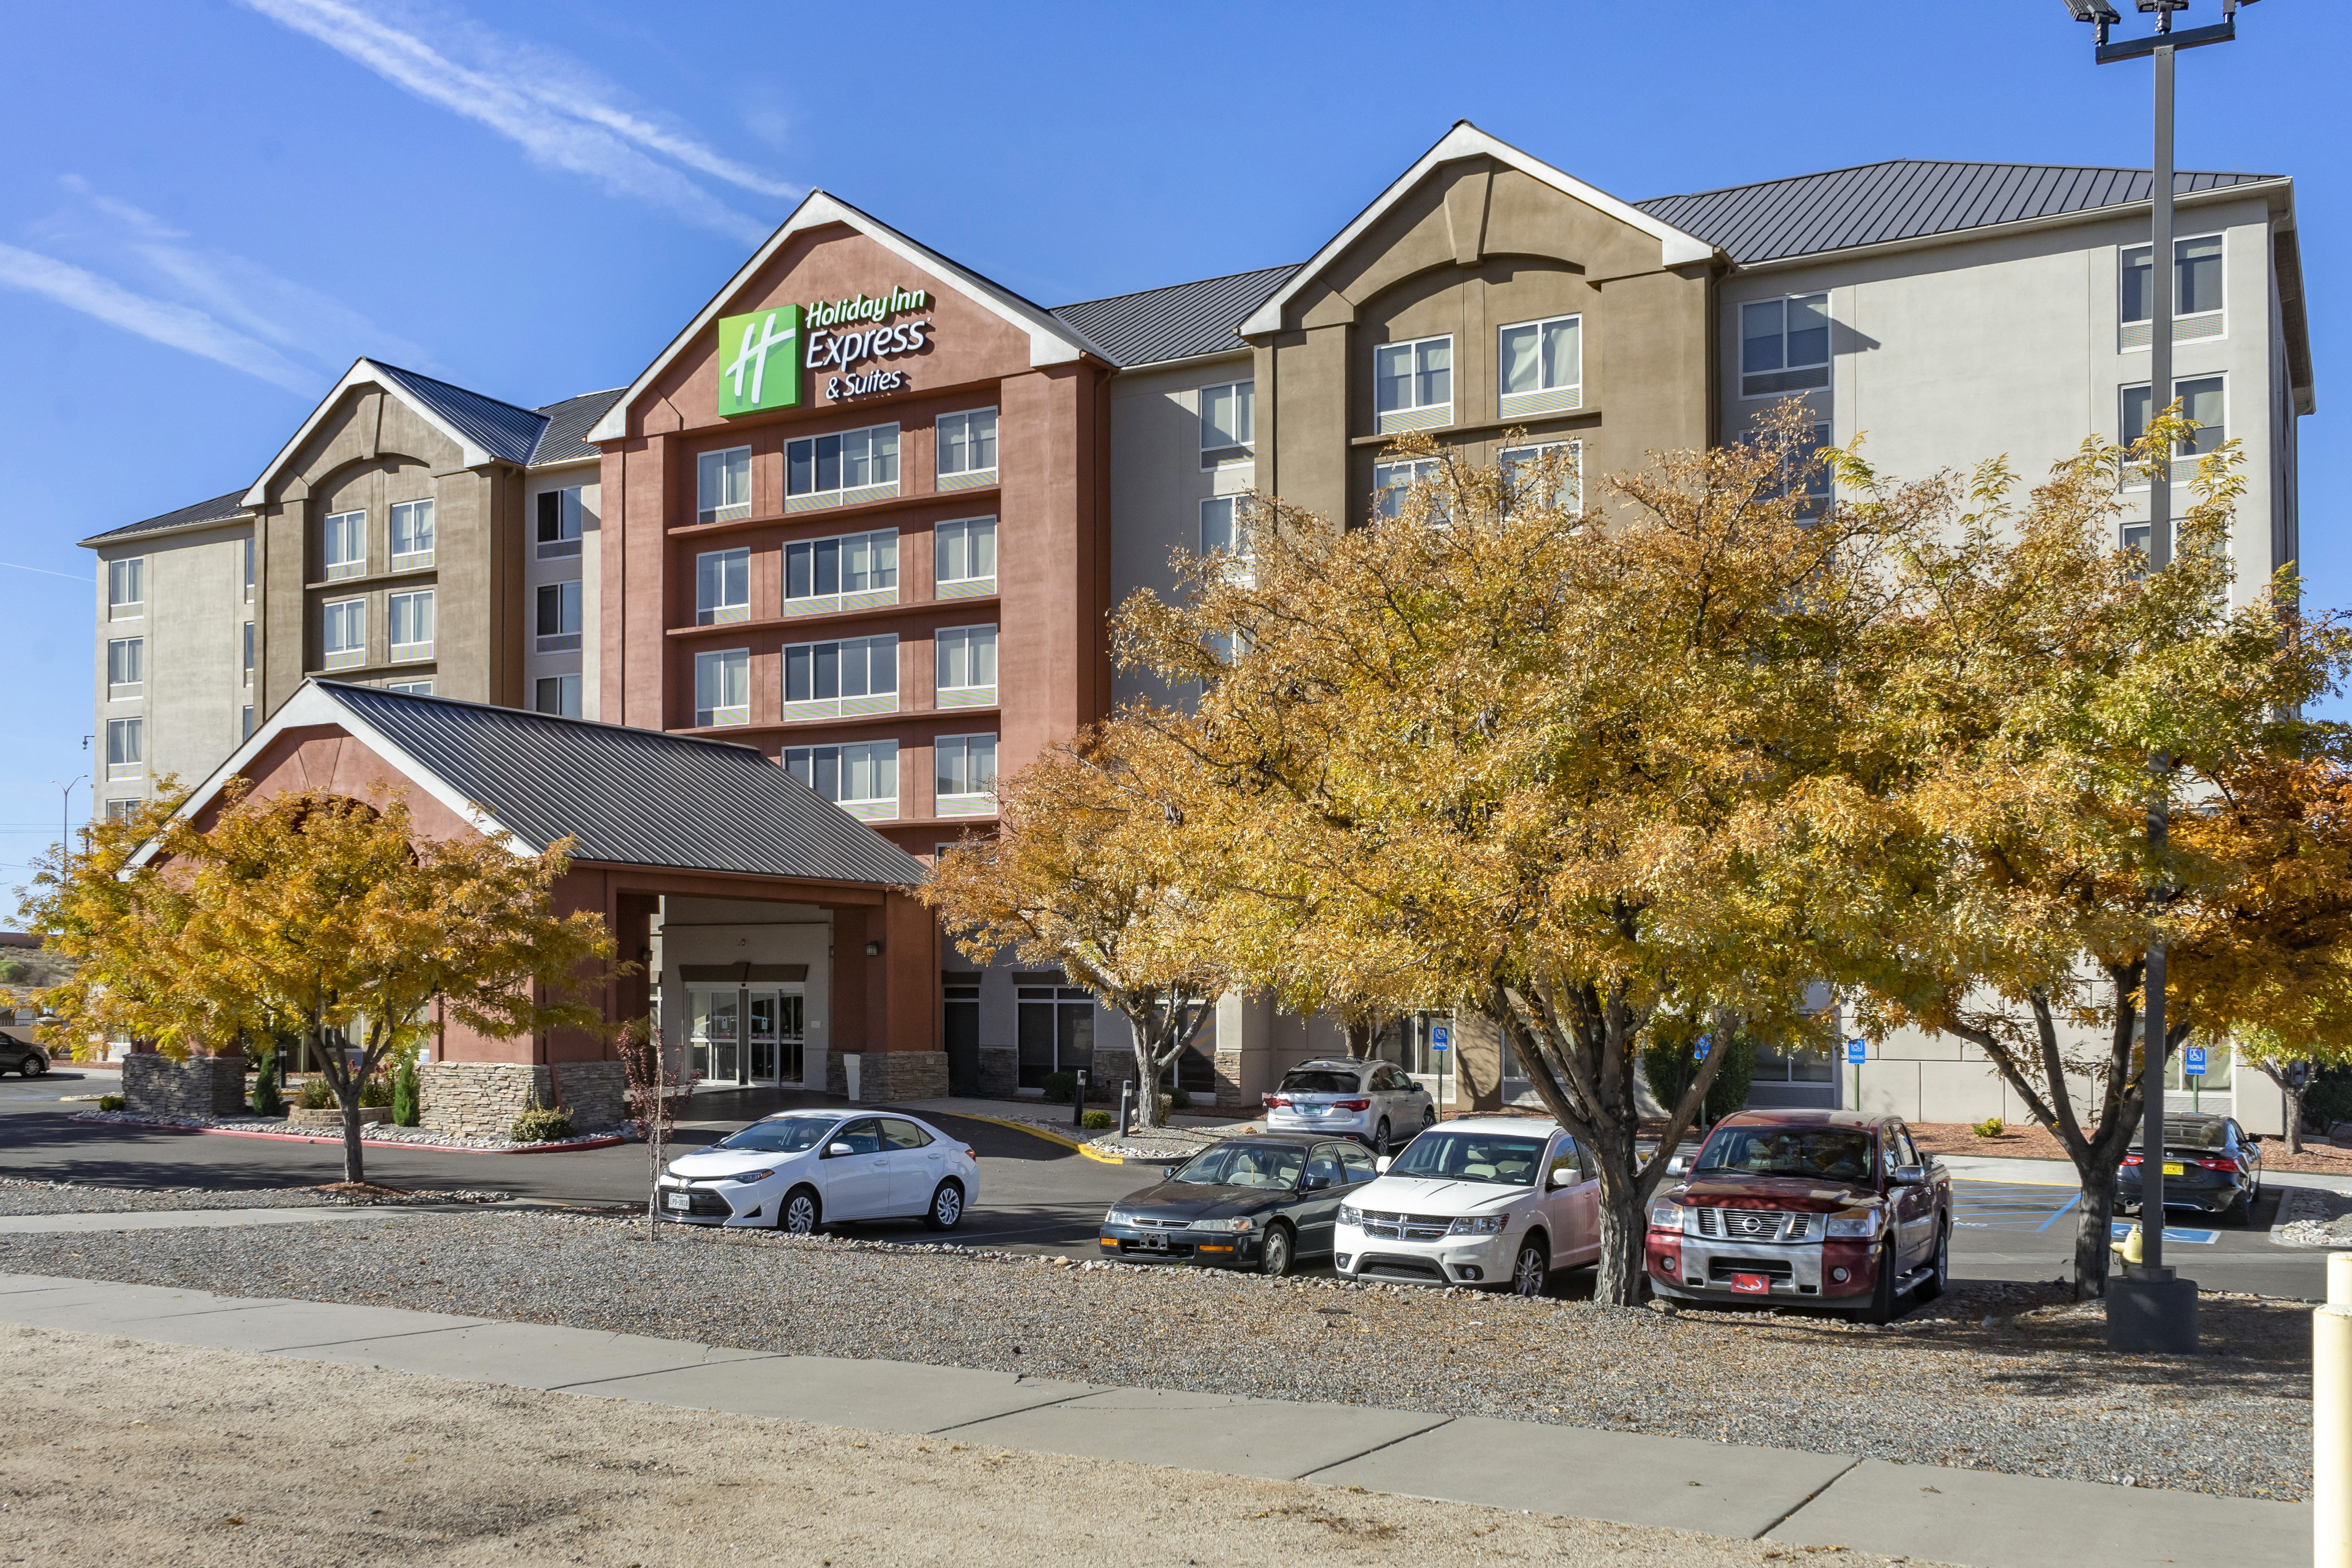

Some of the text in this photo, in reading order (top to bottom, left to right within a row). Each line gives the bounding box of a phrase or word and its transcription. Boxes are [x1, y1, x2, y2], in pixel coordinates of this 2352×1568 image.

[805, 285, 925, 329] Holiday Inn
[806, 321, 925, 372] Express
[825, 369, 901, 399] & Suites
